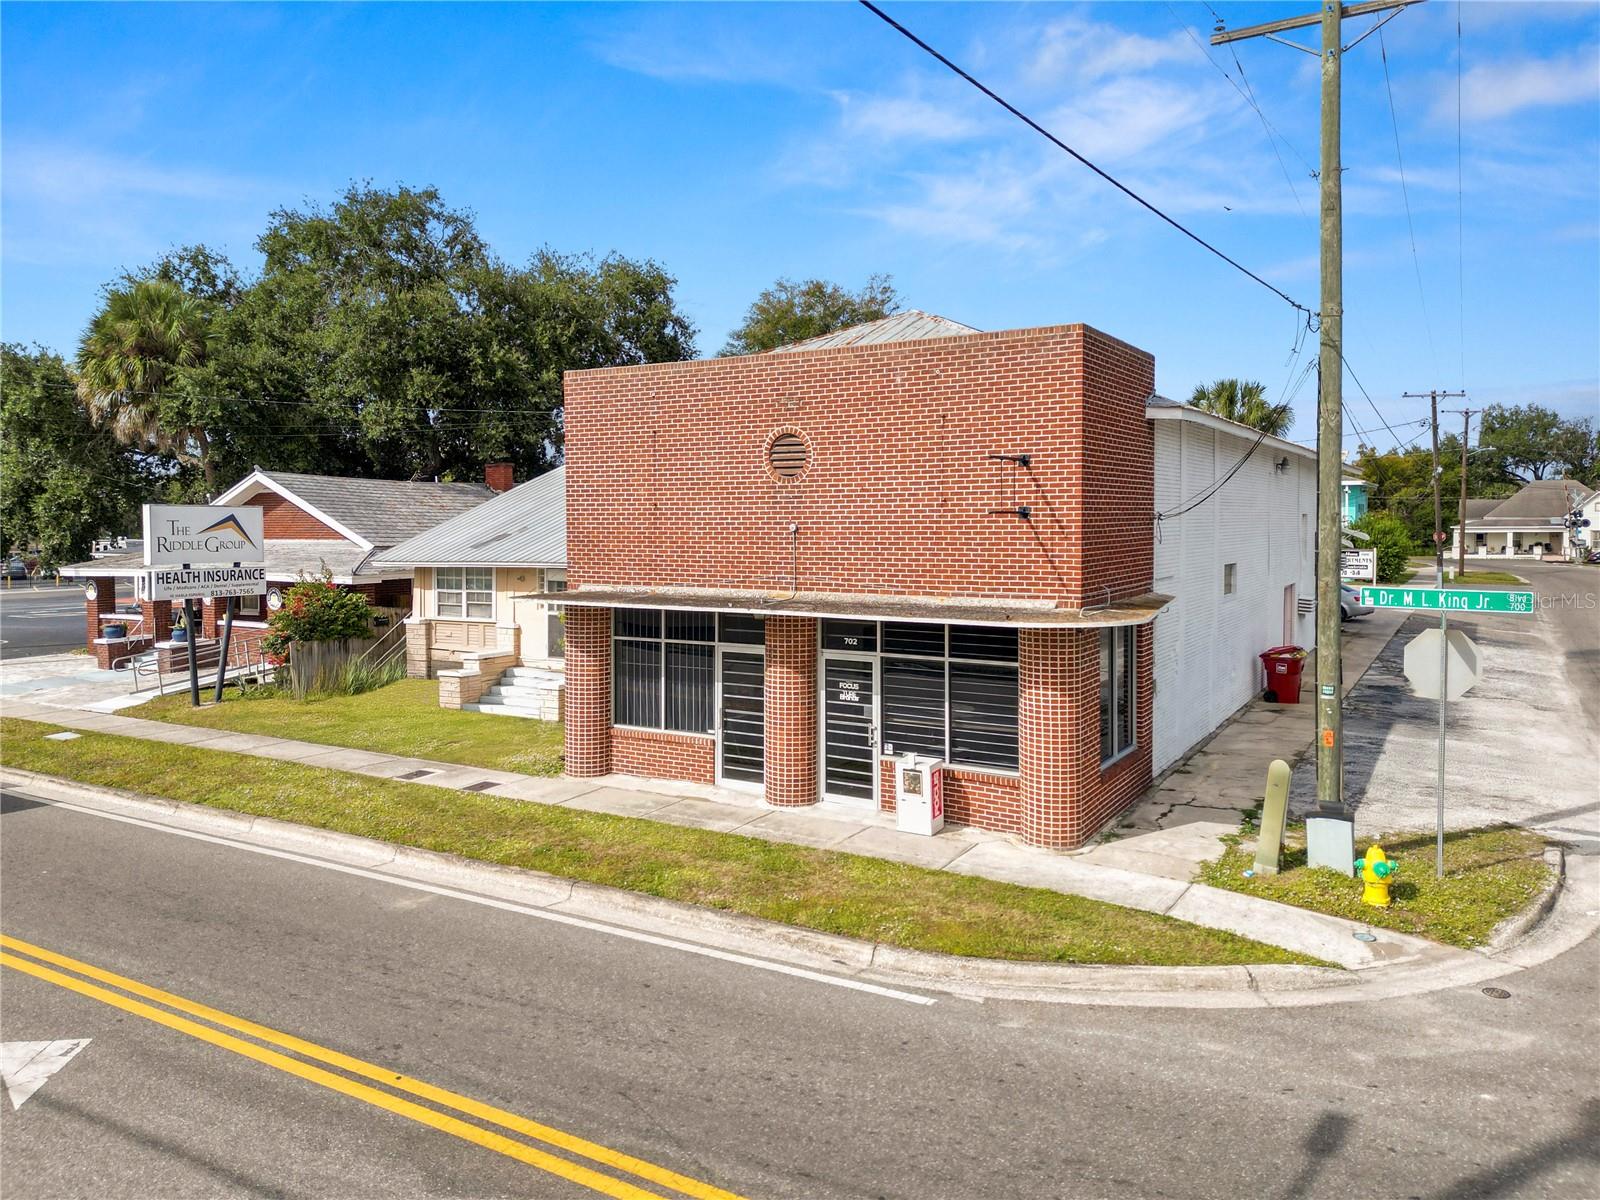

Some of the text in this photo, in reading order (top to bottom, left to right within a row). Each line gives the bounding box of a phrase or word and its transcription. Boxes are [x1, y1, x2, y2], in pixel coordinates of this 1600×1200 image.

[166, 519, 191, 536] THE
[157, 536, 246, 553] RIDDLE GROUP
[156, 570, 201, 585] HEALTH
[203, 568, 265, 583] INSURANCE
[210, 588, 255, 597] 813-763-7565
[1380, 590, 1398, 605] Dr.
[1403, 591, 1415, 606] M.
[1422, 592, 1433, 607] L.
[1438, 592, 1468, 610] King
[1475, 593, 1493, 609] Jr.
[1509, 594, 1527, 603] Blvd
[1509, 603, 1526, 611] 700
[843, 636, 858, 646] 702
[839, 682, 859, 690] FOCUS
